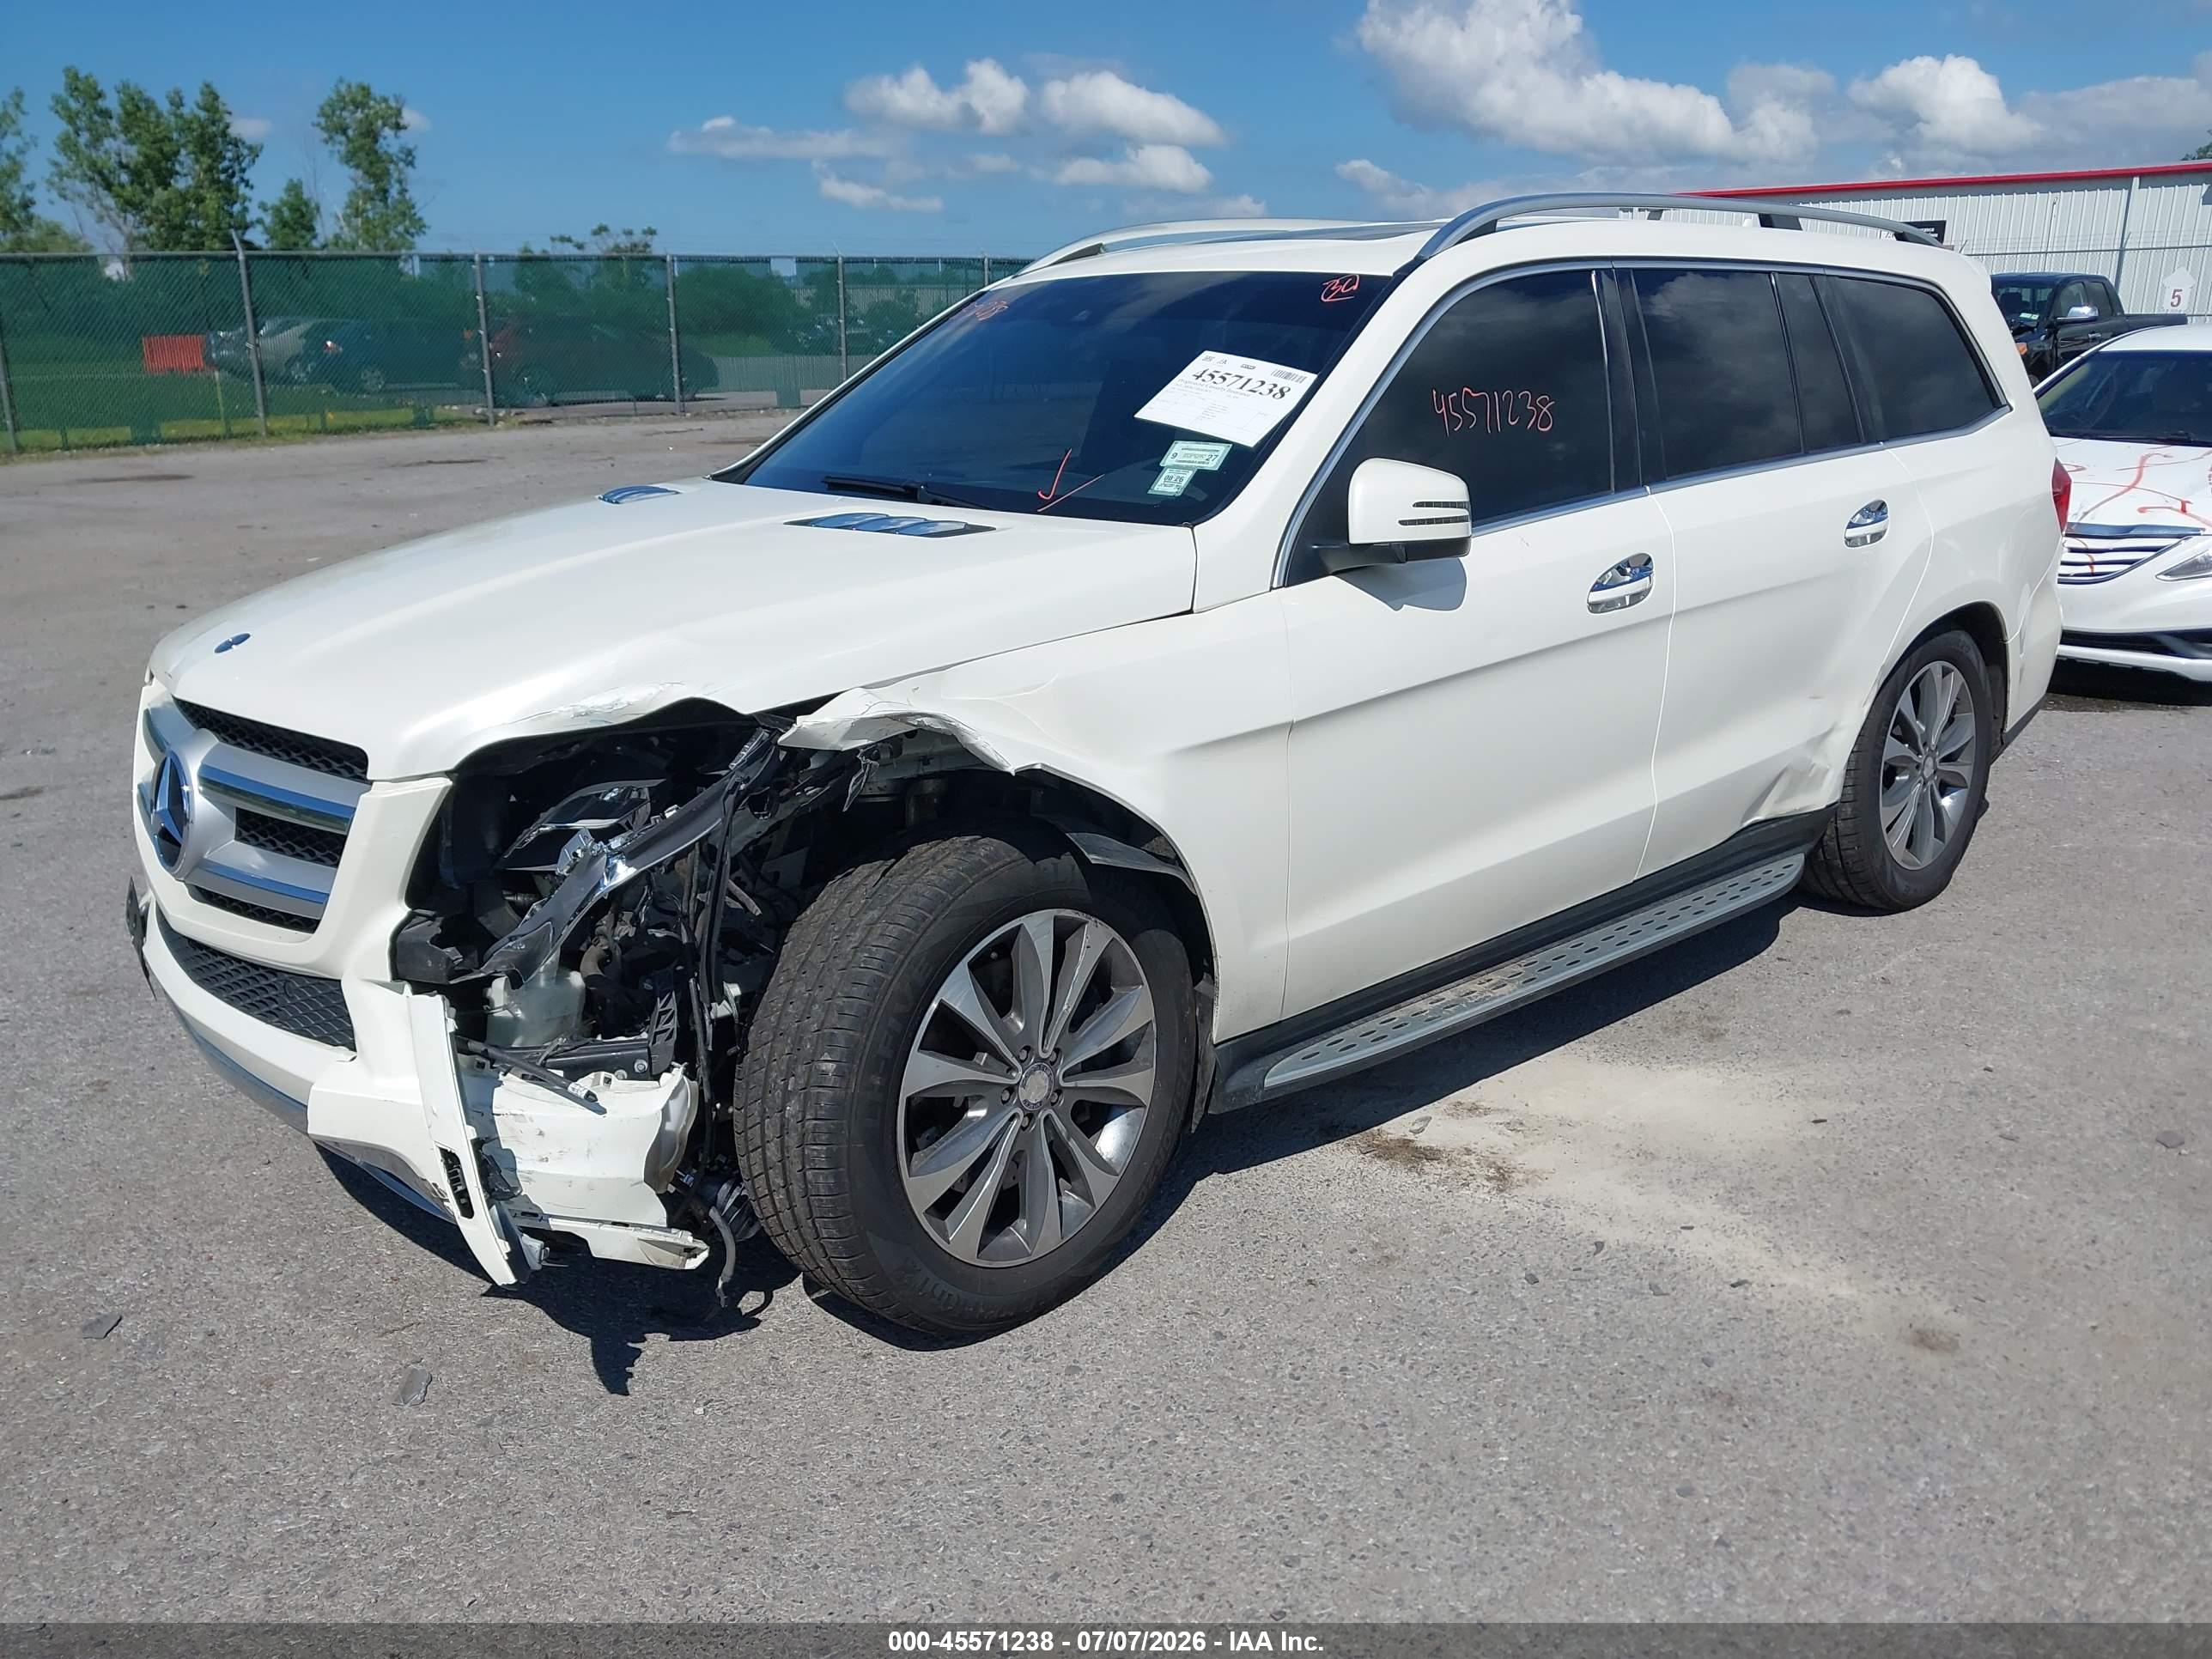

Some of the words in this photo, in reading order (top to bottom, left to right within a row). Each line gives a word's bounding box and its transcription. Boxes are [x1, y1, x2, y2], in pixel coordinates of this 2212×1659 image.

[2170, 289, 2183, 307] 5
[1192, 368, 1291, 400] 45571238
[1432, 386, 1556, 437] 45571238
